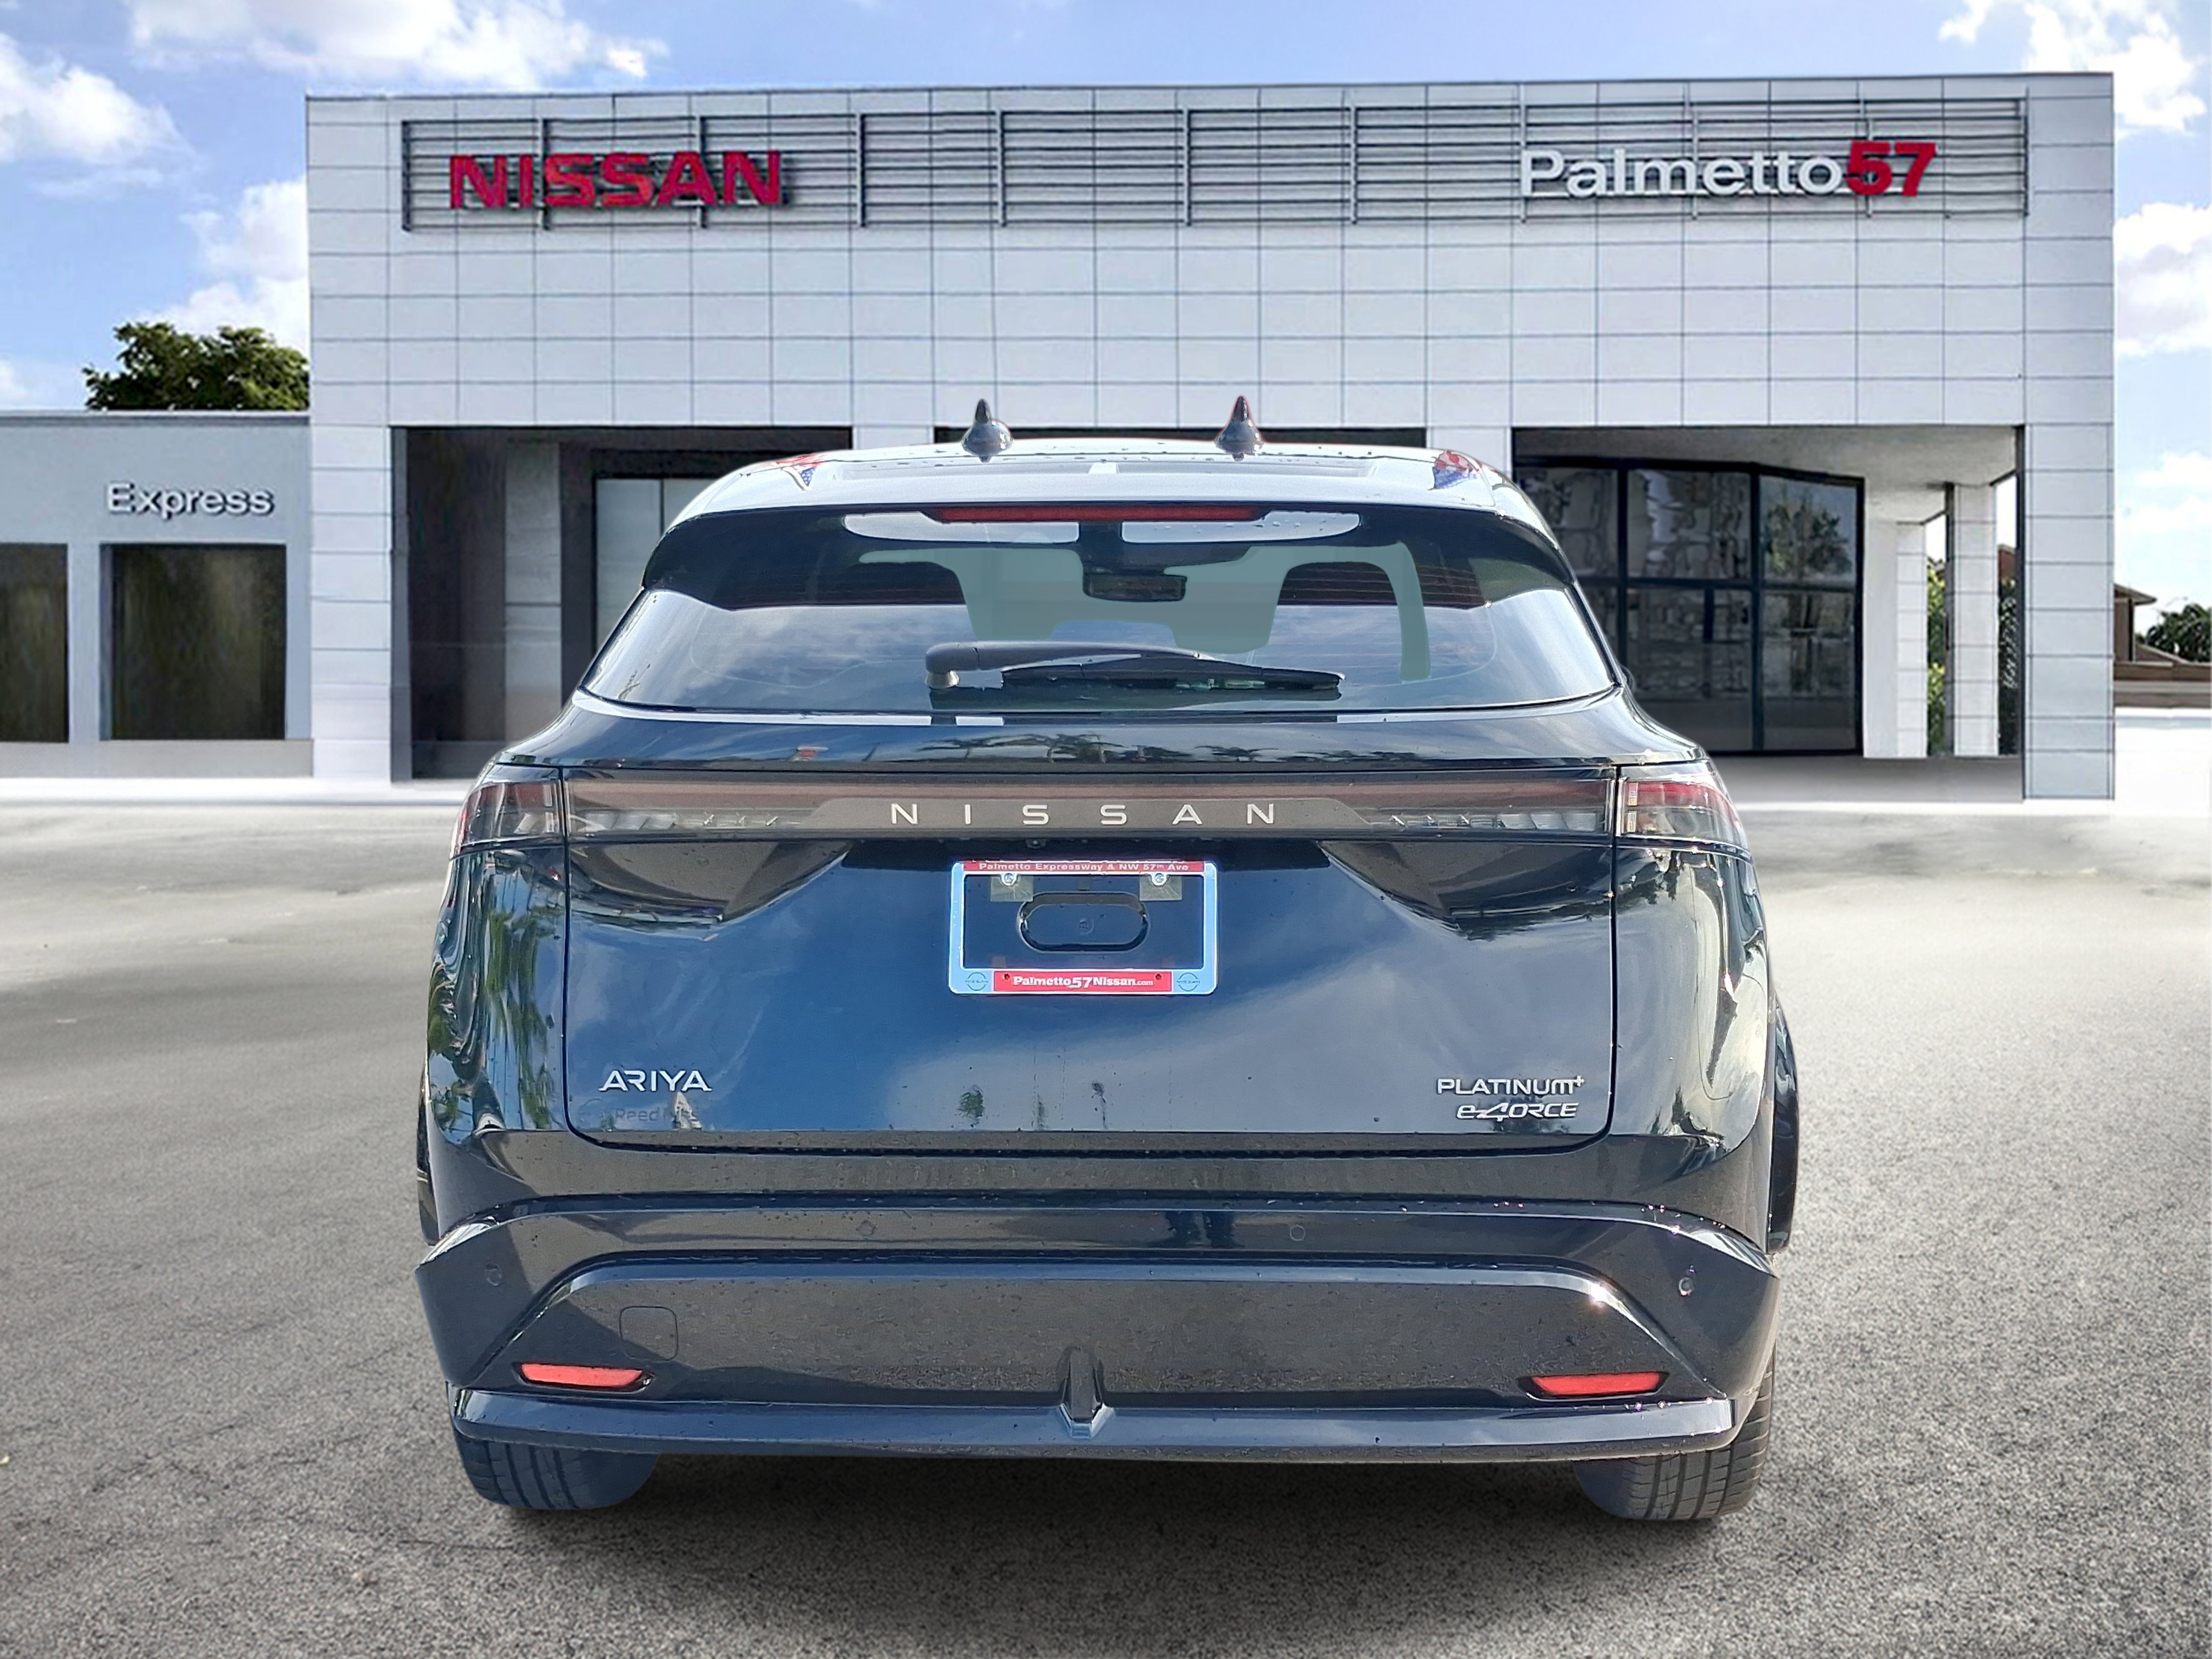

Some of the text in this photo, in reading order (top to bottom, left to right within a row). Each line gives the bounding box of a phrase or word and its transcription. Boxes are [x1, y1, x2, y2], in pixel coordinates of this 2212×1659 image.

[449, 151, 782, 209] NISSAN
[1520, 141, 1937, 198] Palmetto57
[108, 482, 276, 521] Express
[891, 803, 1275, 825] NISSAN
[1013, 975, 1154, 989] Palmetto57Nissan.com
[598, 1070, 713, 1092] ARIYA
